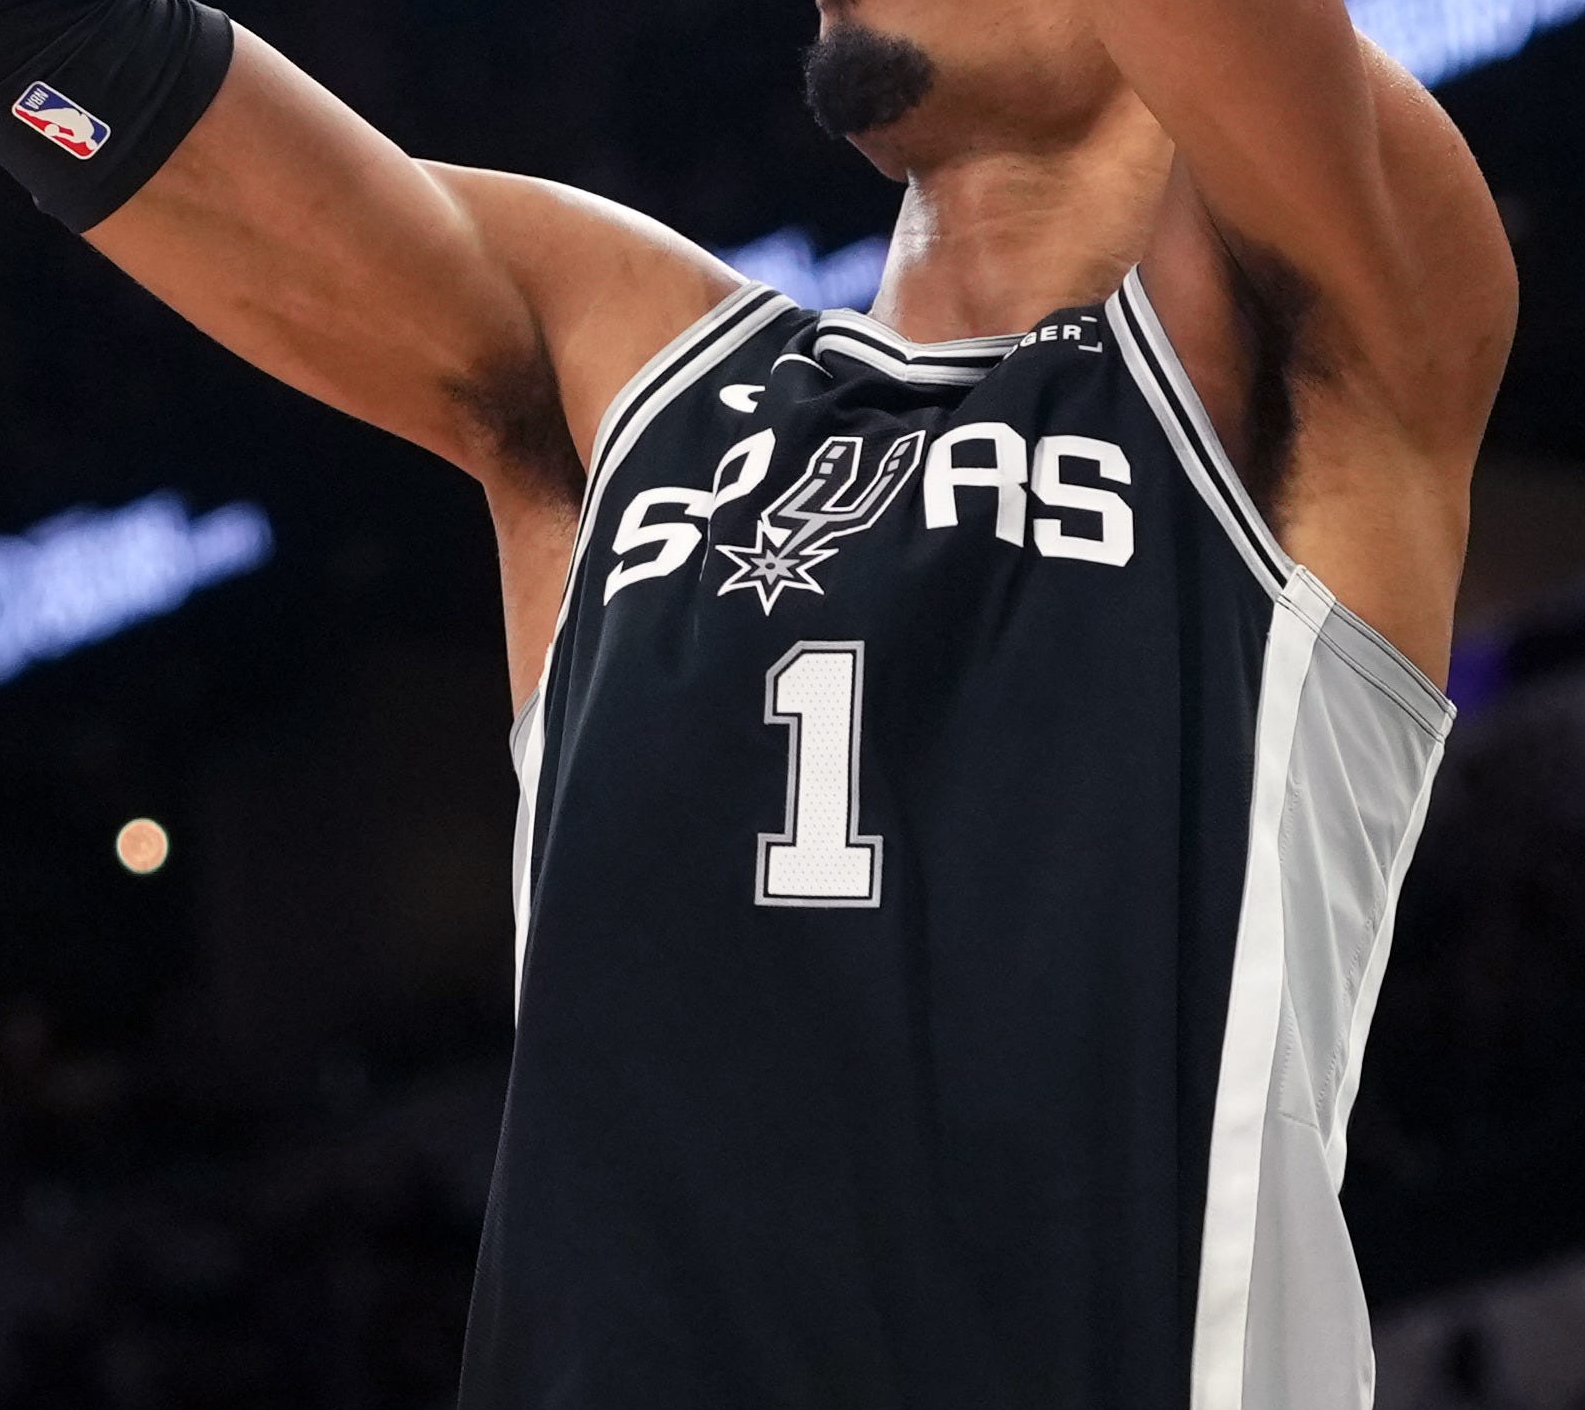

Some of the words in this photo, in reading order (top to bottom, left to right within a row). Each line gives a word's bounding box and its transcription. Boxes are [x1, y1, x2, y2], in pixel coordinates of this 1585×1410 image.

[25, 88, 50, 110] NBA
[604, 422, 1135, 615] SPURS
[754, 640, 884, 908] 1
